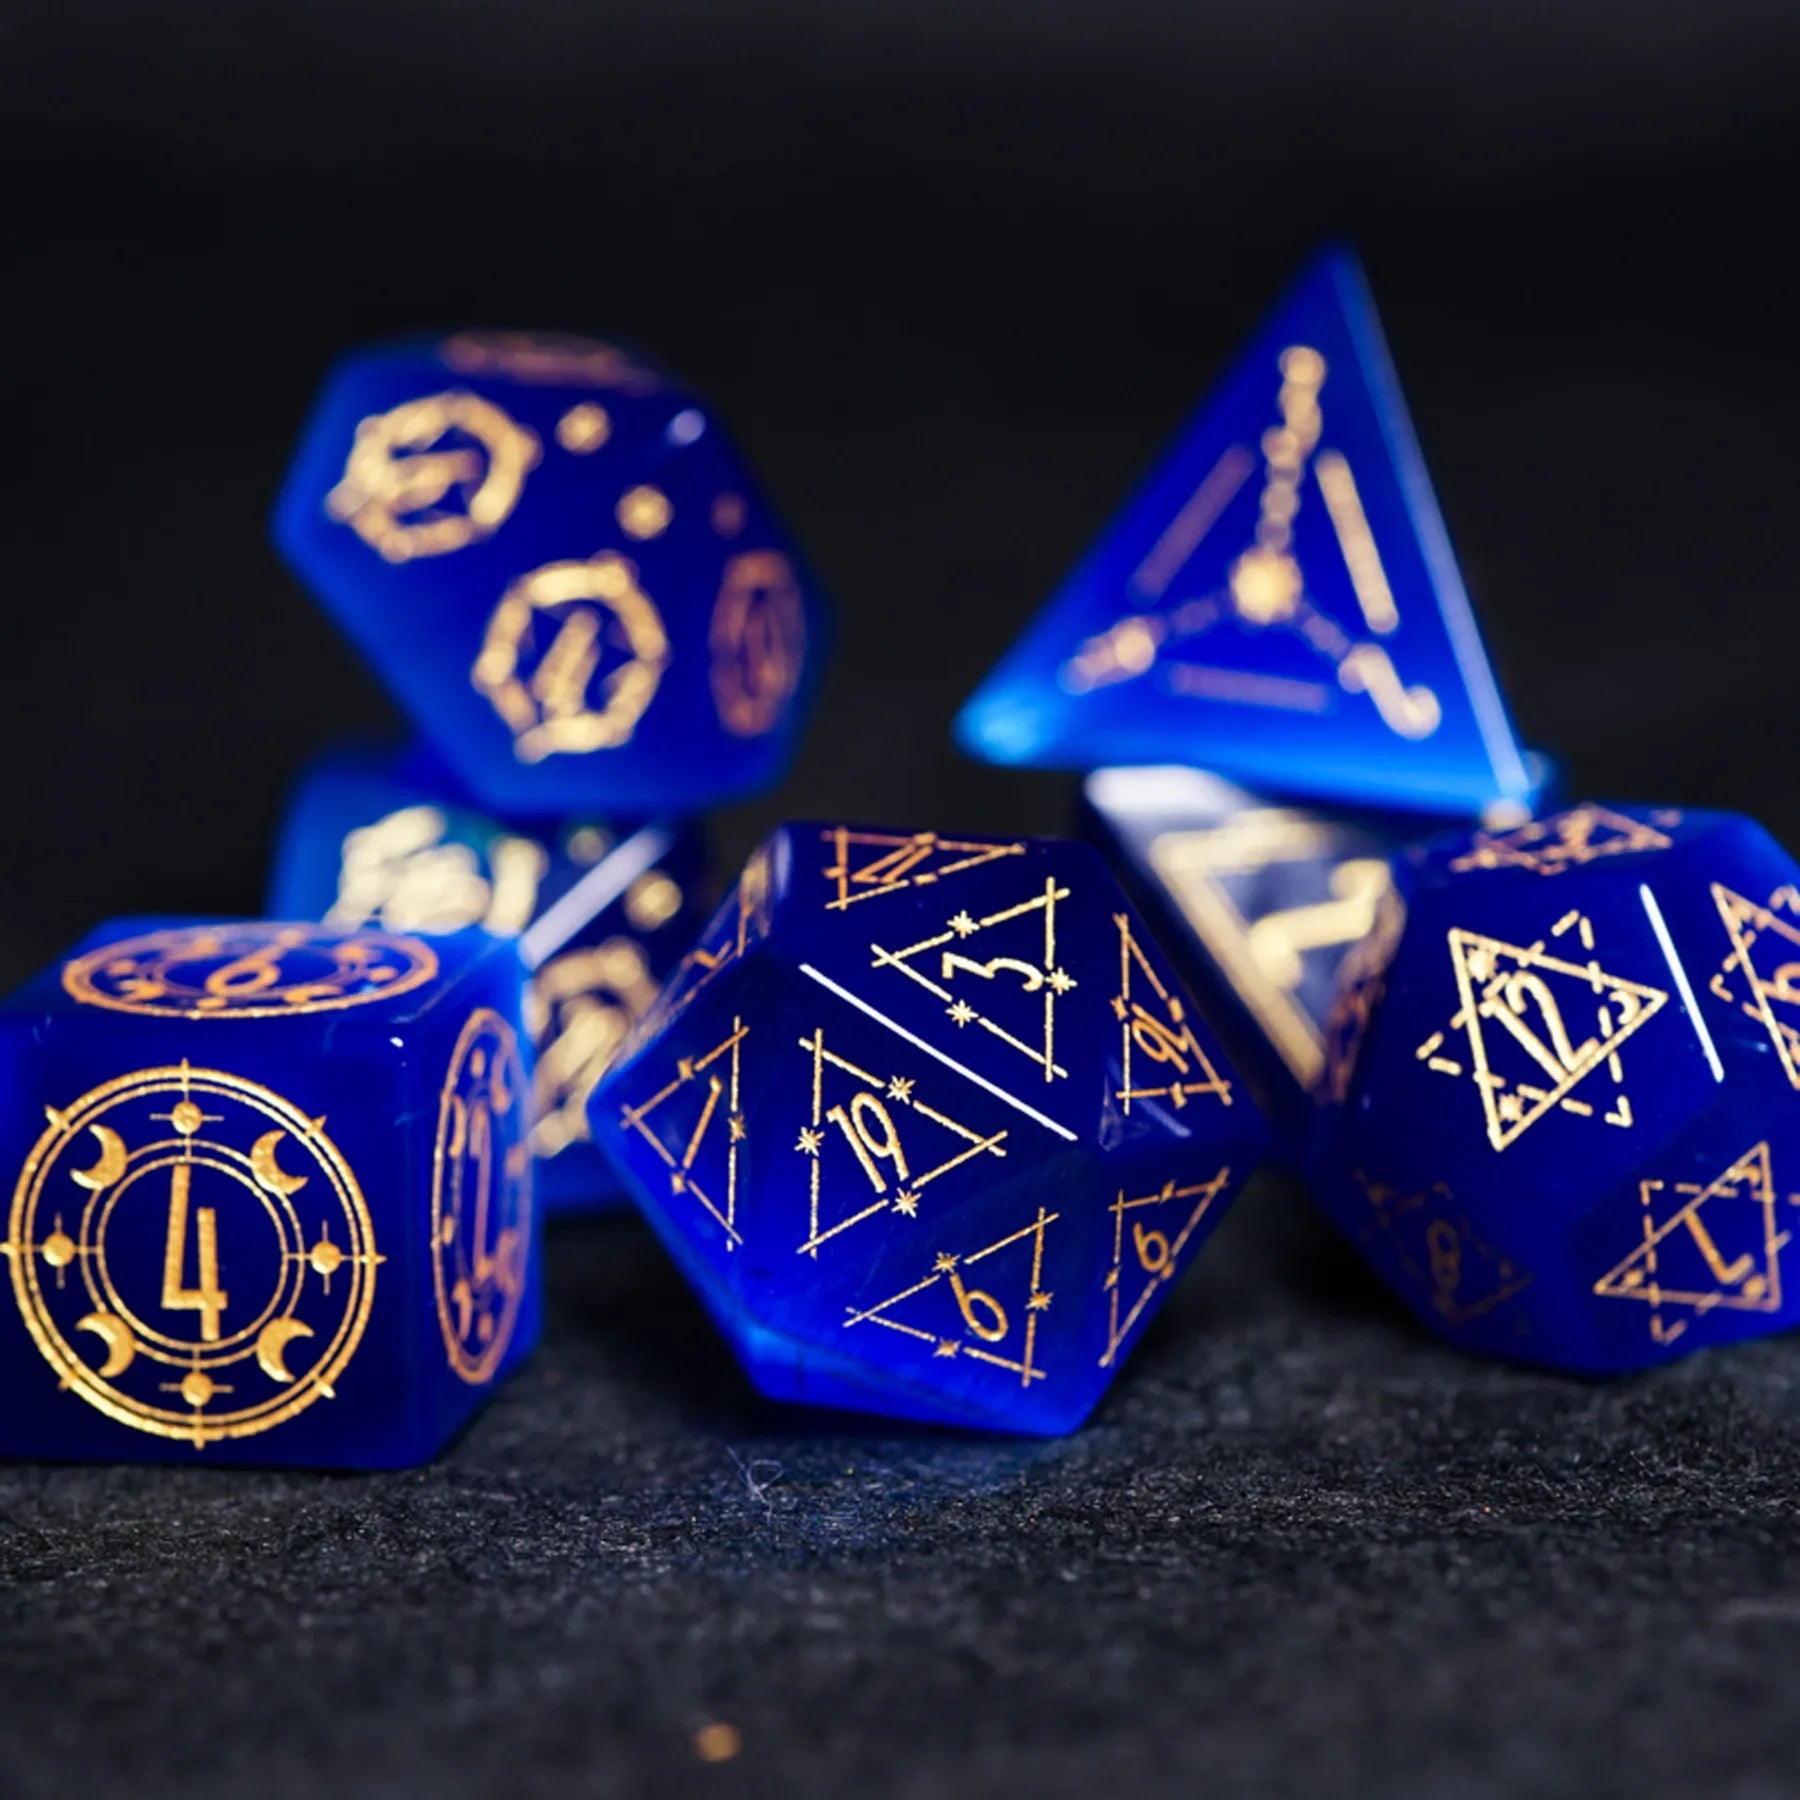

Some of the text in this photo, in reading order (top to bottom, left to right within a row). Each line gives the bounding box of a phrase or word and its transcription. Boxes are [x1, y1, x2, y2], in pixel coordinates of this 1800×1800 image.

[941, 951, 1045, 993] 3
[1480, 970, 1601, 1084] 12
[826, 1091, 909, 1193] 19
[161, 1163, 229, 1342] 4
